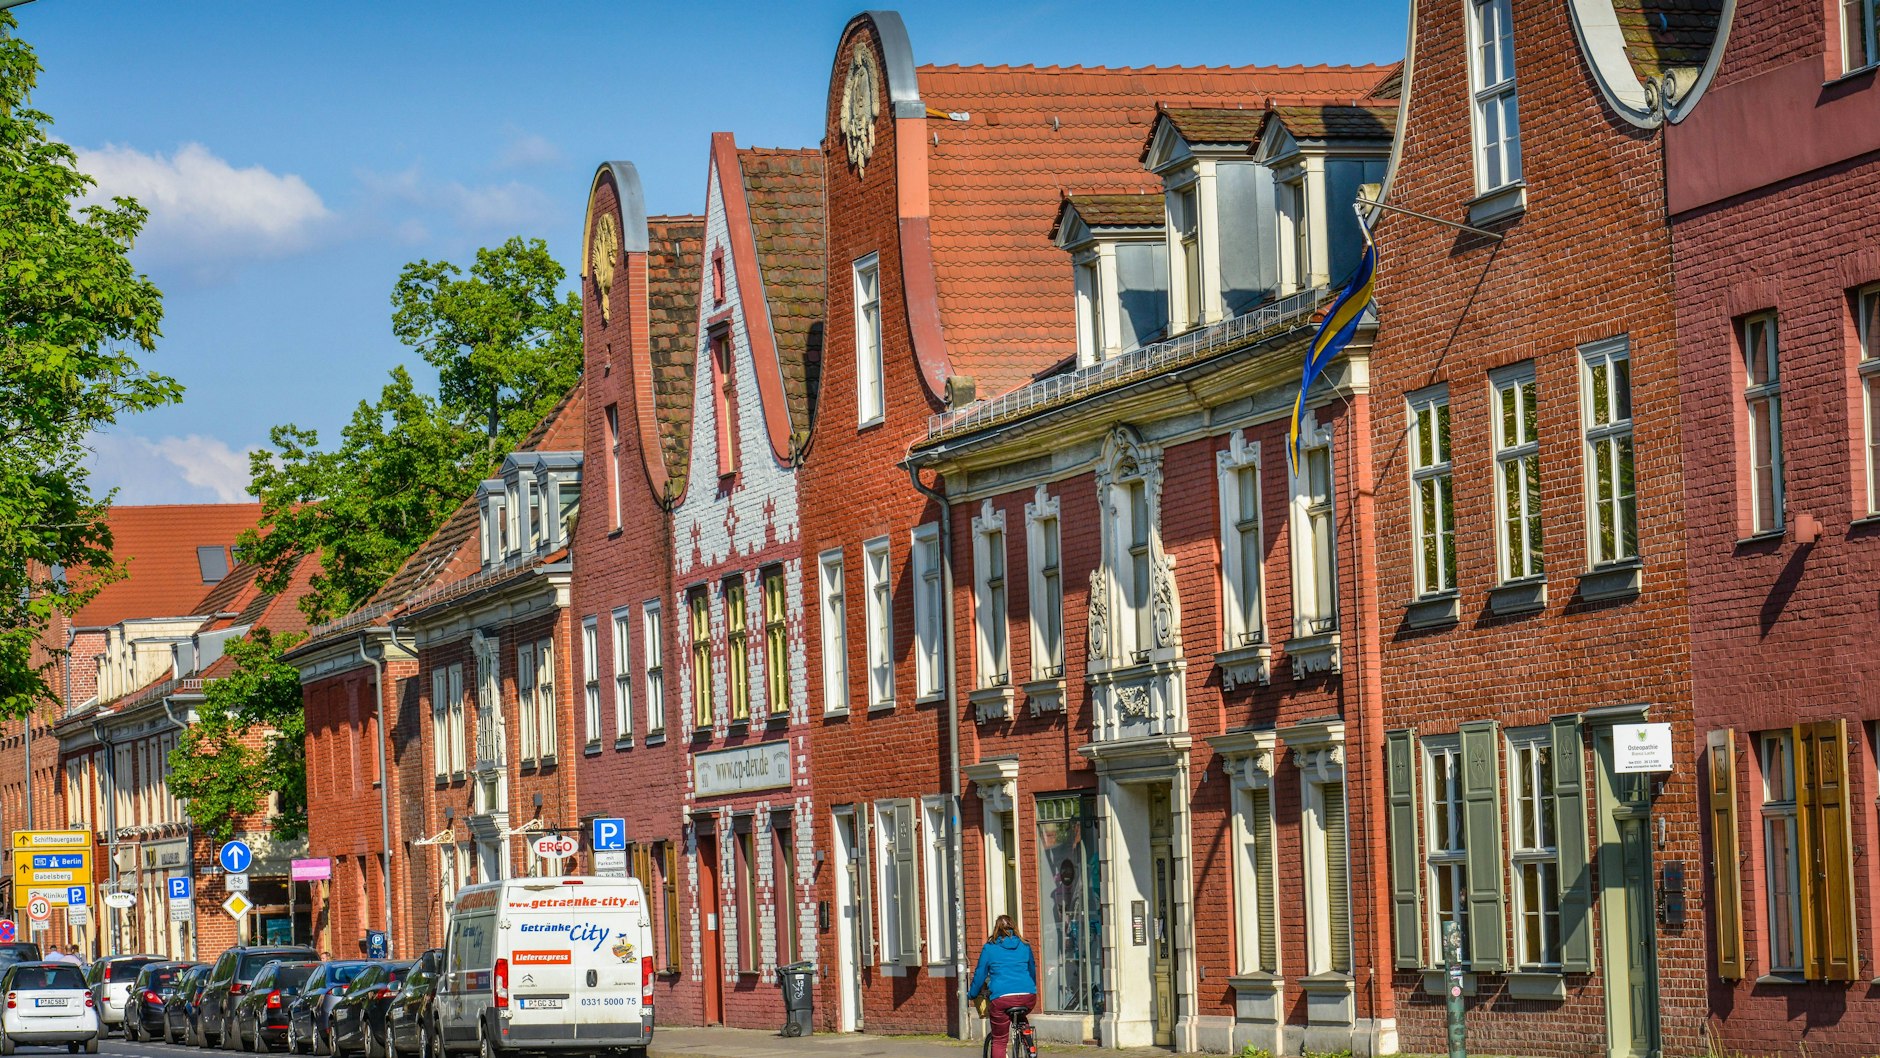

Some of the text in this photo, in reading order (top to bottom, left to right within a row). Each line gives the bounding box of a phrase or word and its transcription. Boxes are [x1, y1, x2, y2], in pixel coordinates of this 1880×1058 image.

[715, 749, 768, 788] www.cp-dev.de
[600, 823, 618, 846] P
[539, 841, 572, 852] ERGO
[173, 880, 184, 896] P
[71, 889, 82, 903] P
[509, 897, 639, 909] www.getraenke-city.de
[32, 902, 46, 914] 30
[520, 922, 609, 952] Getränke City
[581, 998, 600, 1006] 0331
[626, 997, 637, 1005] 75
